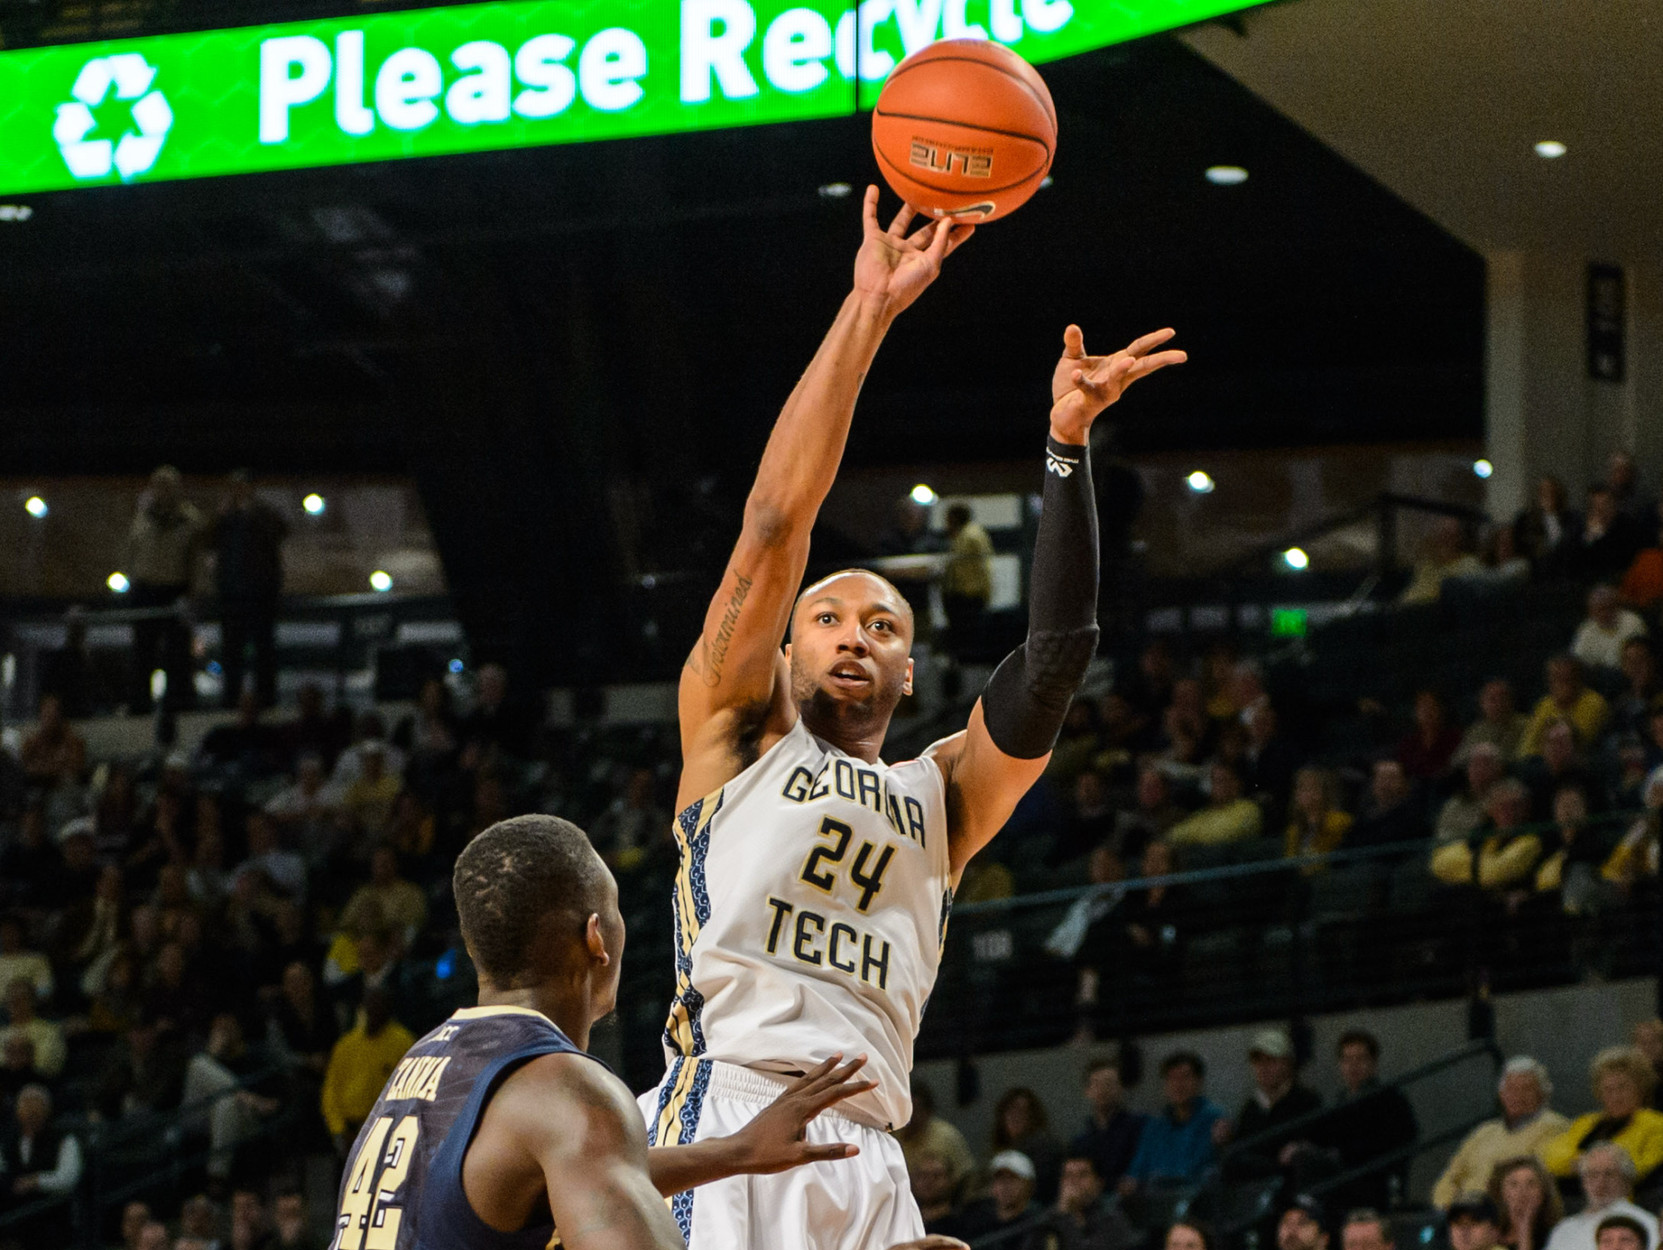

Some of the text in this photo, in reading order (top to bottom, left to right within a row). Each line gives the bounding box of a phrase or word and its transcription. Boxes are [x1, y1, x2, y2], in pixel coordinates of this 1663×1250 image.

[258, 27, 649, 144] Please
[909, 141, 993, 179] ELITE
[799, 814, 898, 914] 24
[765, 895, 891, 991] TECH
